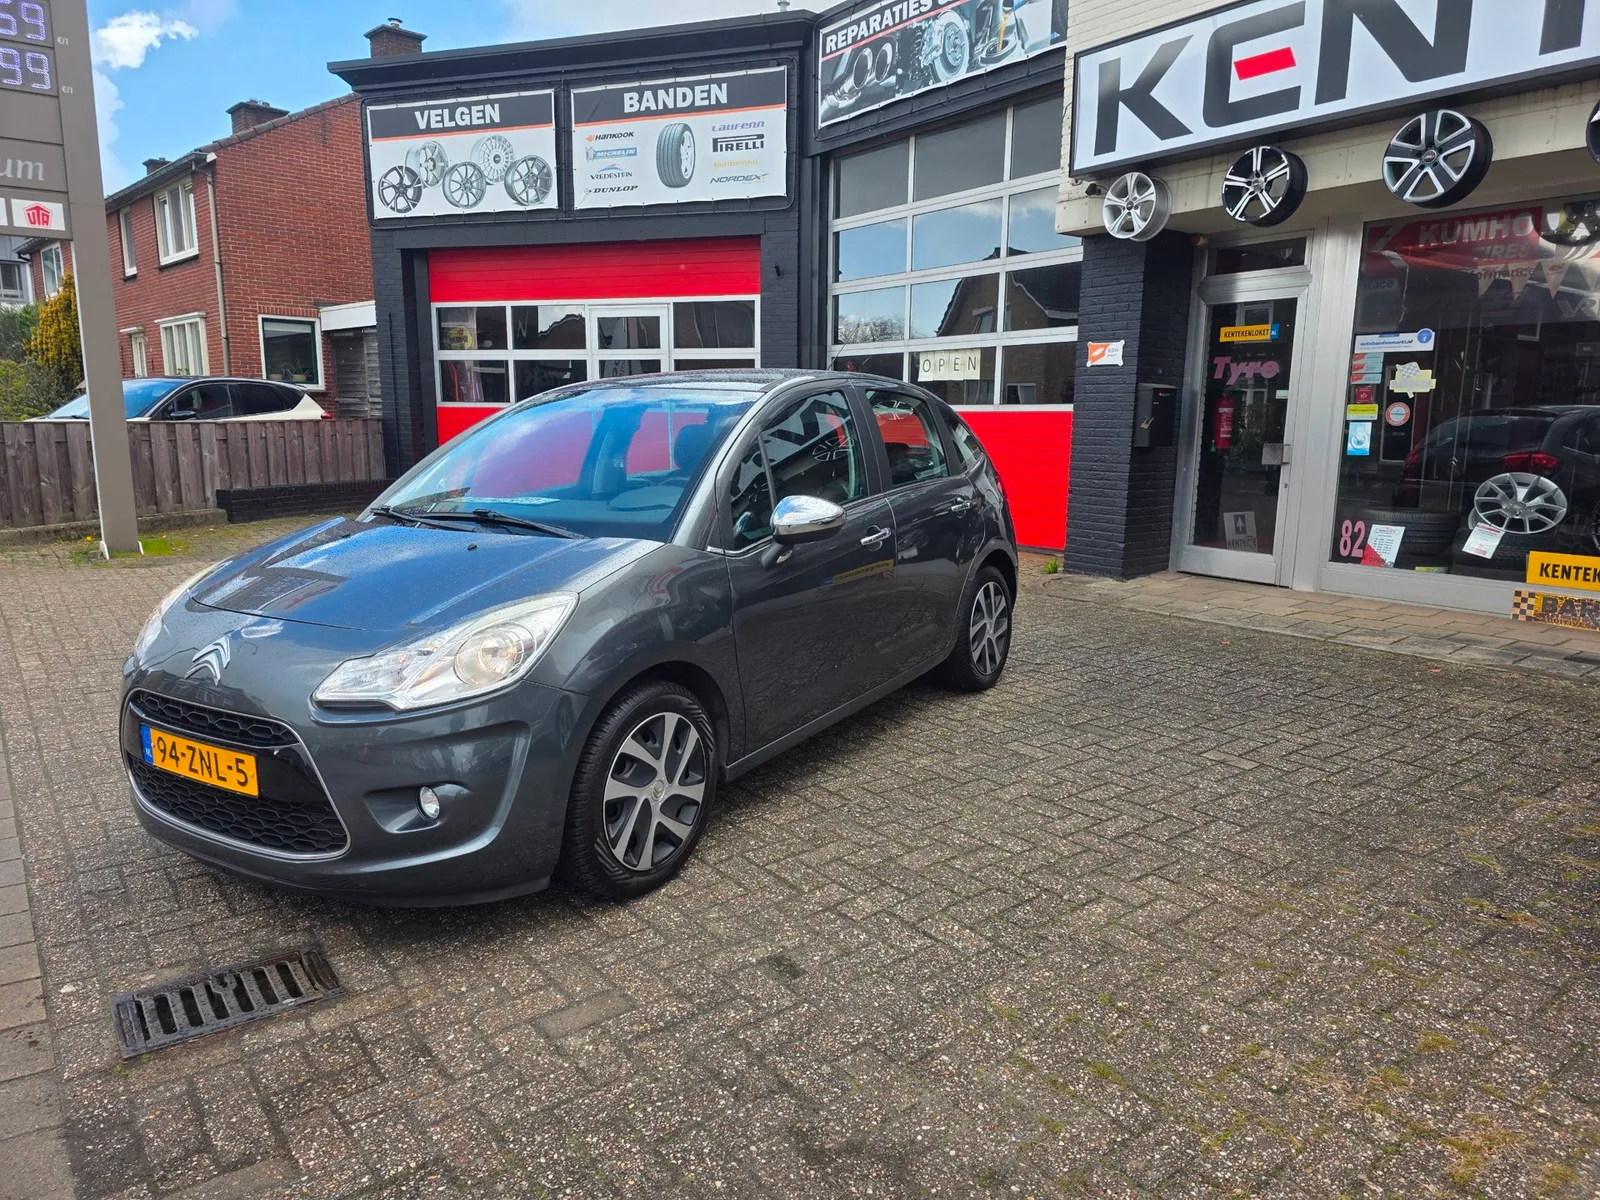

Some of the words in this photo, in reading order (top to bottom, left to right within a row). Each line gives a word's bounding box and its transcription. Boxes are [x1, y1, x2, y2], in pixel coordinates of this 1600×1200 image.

[826, 0, 934, 54] REPARATIES
[0, 47, 51, 90] 99
[1094, 0, 1585, 157] KEN
[623, 82, 728, 113] BANDEN
[414, 103, 500, 129] VELGEN
[596, 149, 636, 157] MICHELIN
[712, 133, 765, 153] PIRELLI
[590, 172, 633, 180] VREDESTEIN
[710, 174, 764, 184] NORDEX
[593, 185, 638, 194] DUNLOP
[26, 205, 51, 226] UTA
[1418, 211, 1536, 247] KUMHO
[1224, 329, 1270, 339] KENTEKENLOKET
[922, 355, 977, 373] OPEN
[1339, 519, 1366, 558] 82
[157, 736, 248, 787] 94-ZNL-5
